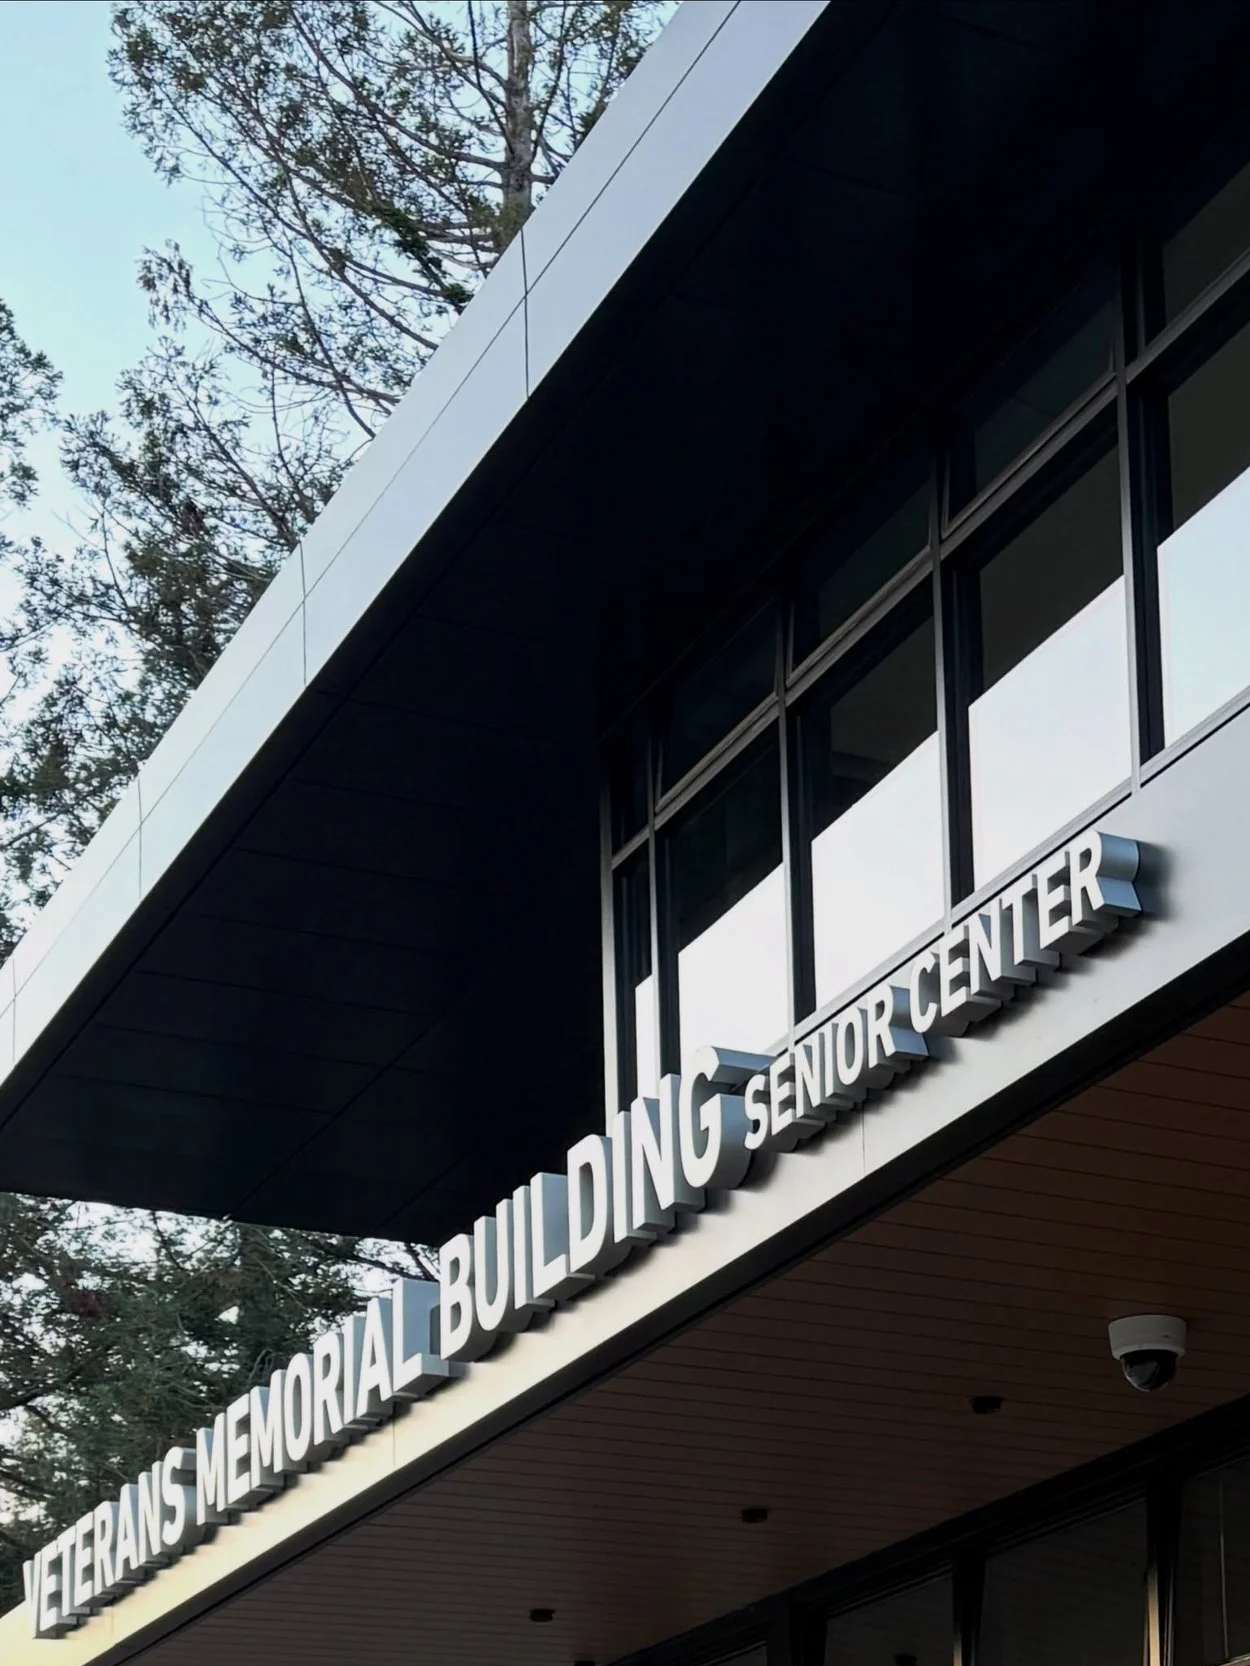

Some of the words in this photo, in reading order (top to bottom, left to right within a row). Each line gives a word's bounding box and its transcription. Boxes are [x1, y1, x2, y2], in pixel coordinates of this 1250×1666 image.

[22, 1447, 186, 1636] VETERANS
[196, 1278, 424, 1525] MEMORIAL
[438, 1044, 723, 1361] BUILDING
[743, 984, 898, 1151] SENIOR
[909, 829, 1106, 1034] CENTER
